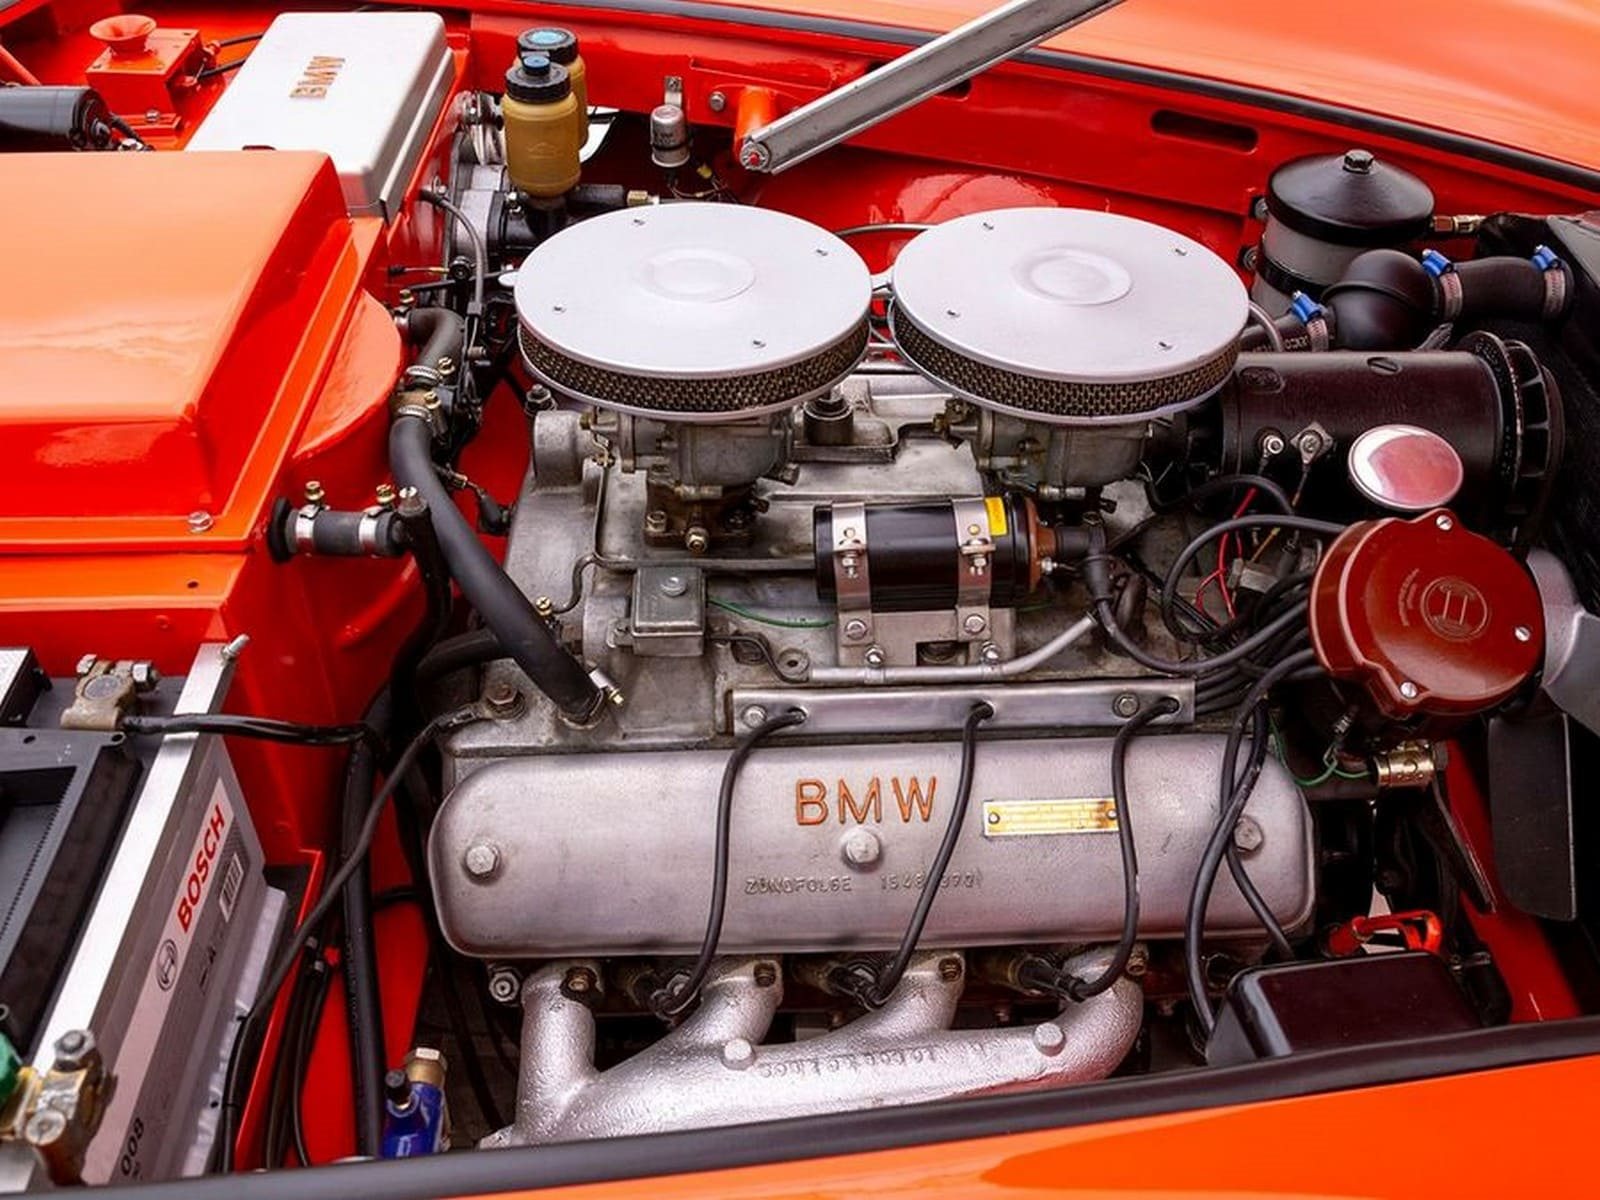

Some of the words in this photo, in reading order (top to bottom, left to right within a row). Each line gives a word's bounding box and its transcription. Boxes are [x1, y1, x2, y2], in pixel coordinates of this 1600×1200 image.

[288, 56, 346, 99] BMW
[795, 776, 937, 826] BMW
[177, 804, 225, 933] BOSCH
